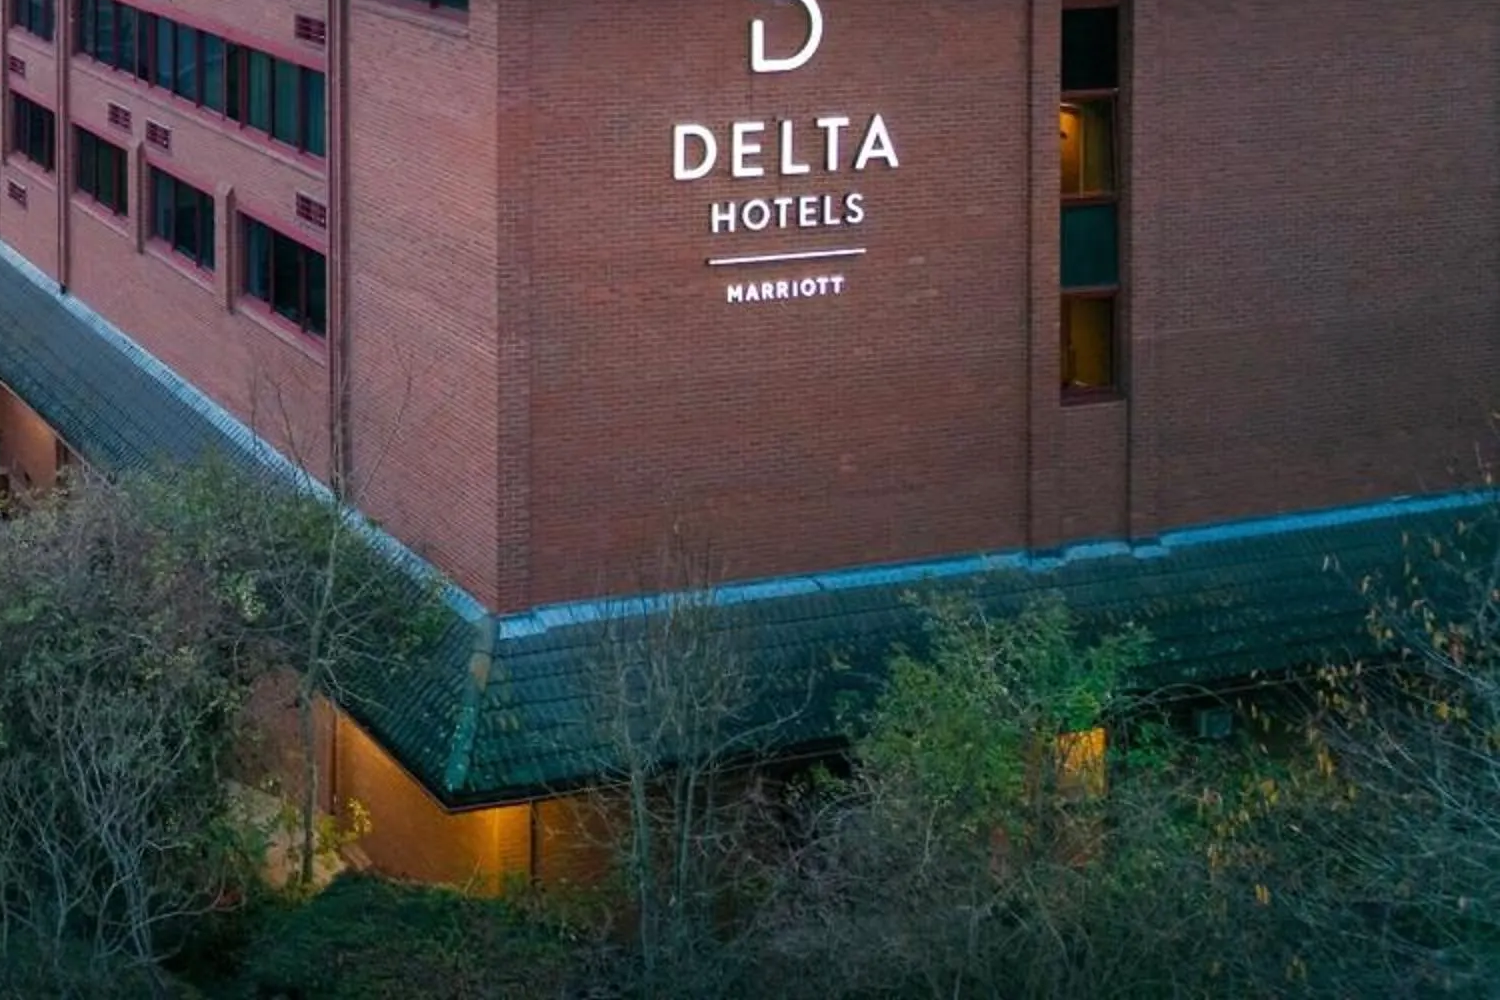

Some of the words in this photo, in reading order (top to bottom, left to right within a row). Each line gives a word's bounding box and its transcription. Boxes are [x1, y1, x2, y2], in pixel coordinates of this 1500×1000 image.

[673, 113, 899, 181] DELTA
[711, 194, 865, 233] HOTELS
[726, 276, 845, 303] MARRIOTT
